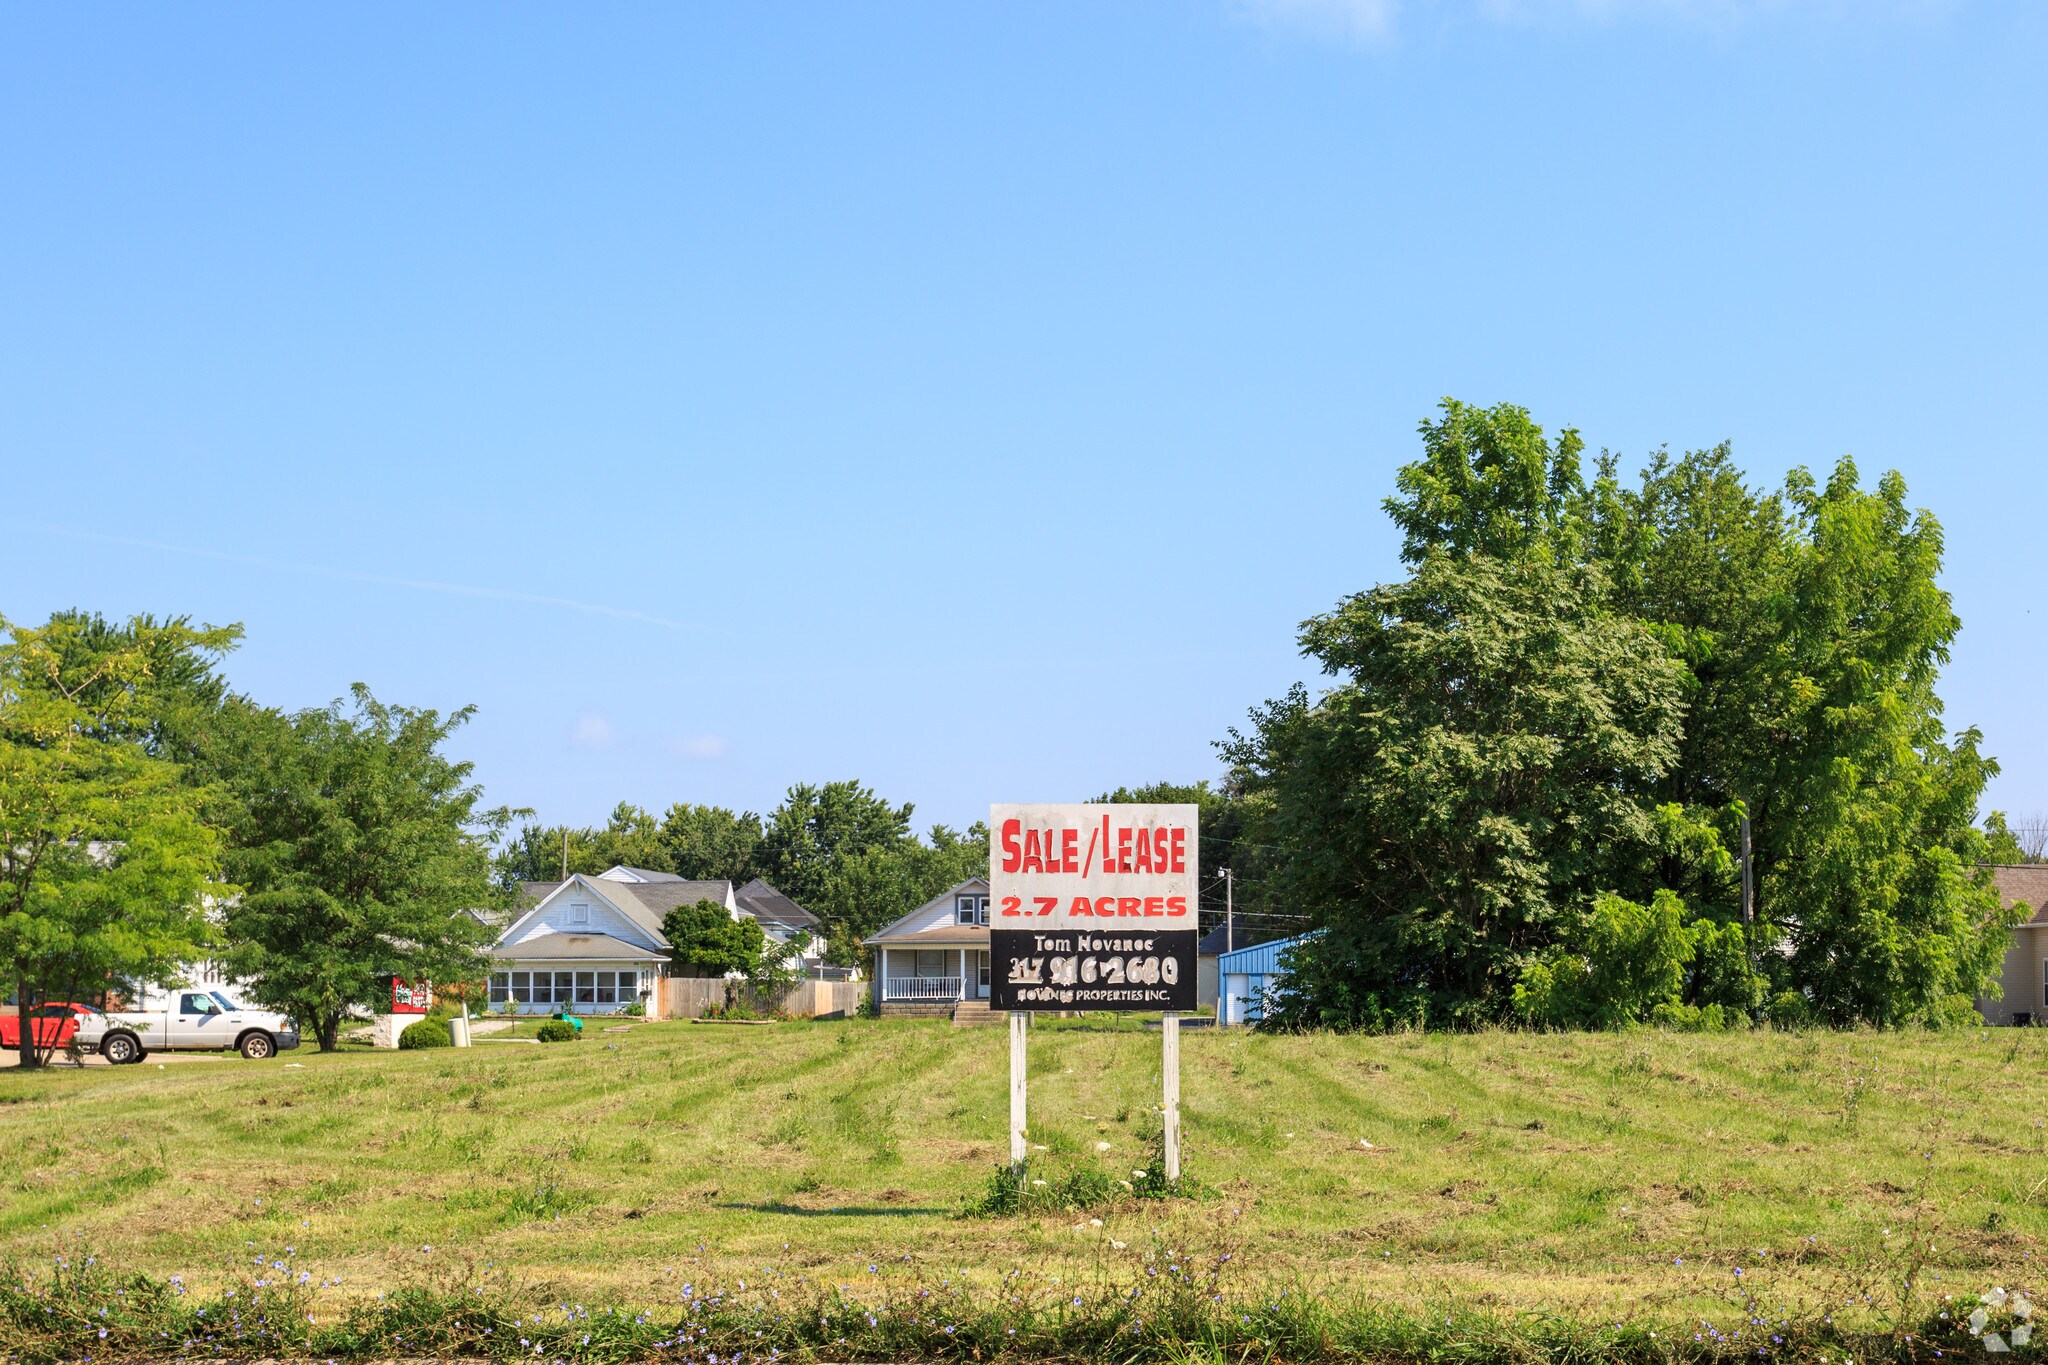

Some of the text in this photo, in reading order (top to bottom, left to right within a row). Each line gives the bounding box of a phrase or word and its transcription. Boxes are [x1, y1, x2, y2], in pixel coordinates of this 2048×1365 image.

[1001, 814, 1185, 879] SALE/LEASE
[1001, 896, 1187, 917] 2.7 ACRES
[1034, 935, 1071, 952] Tom
[1076, 990, 1144, 1001] PROPERTIES
[1145, 990, 1171, 1001] INC.
